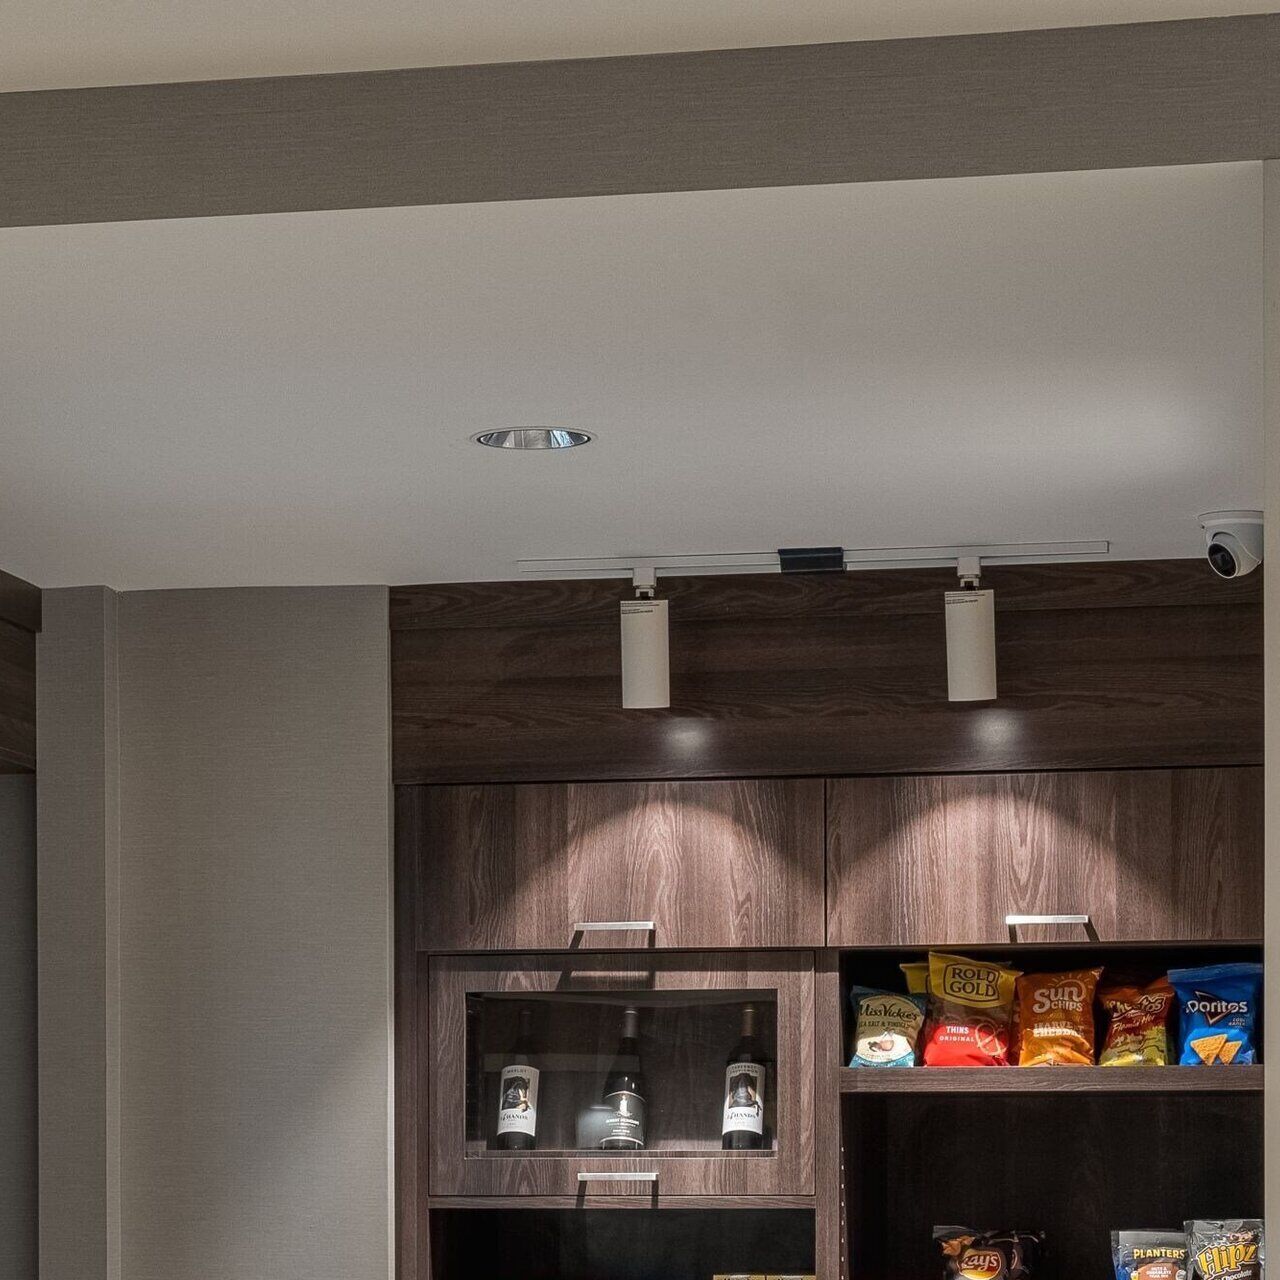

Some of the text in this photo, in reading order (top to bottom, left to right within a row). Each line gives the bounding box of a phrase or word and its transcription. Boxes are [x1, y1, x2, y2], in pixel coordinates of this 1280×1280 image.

[951, 967, 997, 983] ROLD
[949, 981, 997, 997] GOLD
[1033, 986, 1083, 1013] Sun
[1050, 1001, 1083, 1012] CHIPS
[1185, 1001, 1248, 1014] Doritos
[946, 1026, 970, 1034] THINS
[1133, 1248, 1186, 1260] PLANTERS
[1197, 1243, 1258, 1278] Flipz
